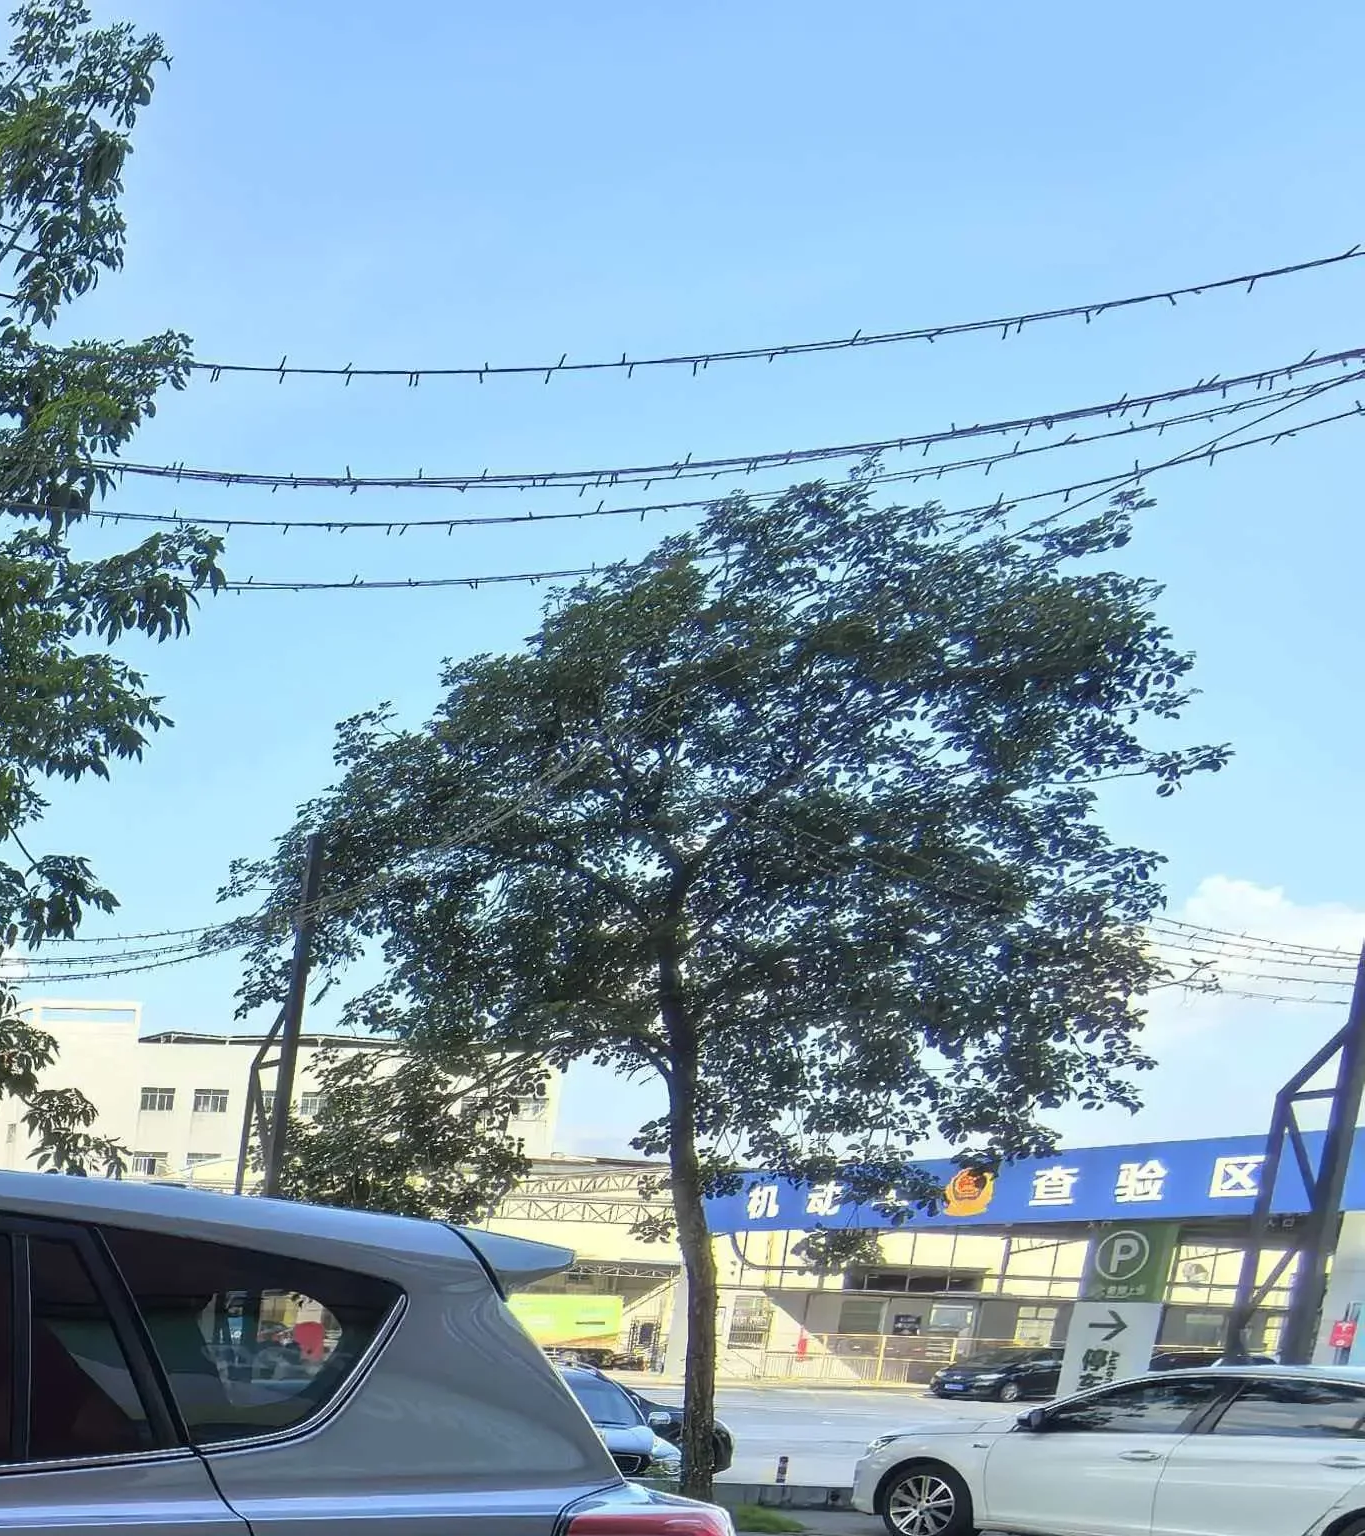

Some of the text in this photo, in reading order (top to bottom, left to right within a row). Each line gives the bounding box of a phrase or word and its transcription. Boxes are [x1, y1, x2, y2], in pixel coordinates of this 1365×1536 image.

[1029, 1153, 1267, 1206] 查验区
[1109, 1237, 1140, 1274] P
